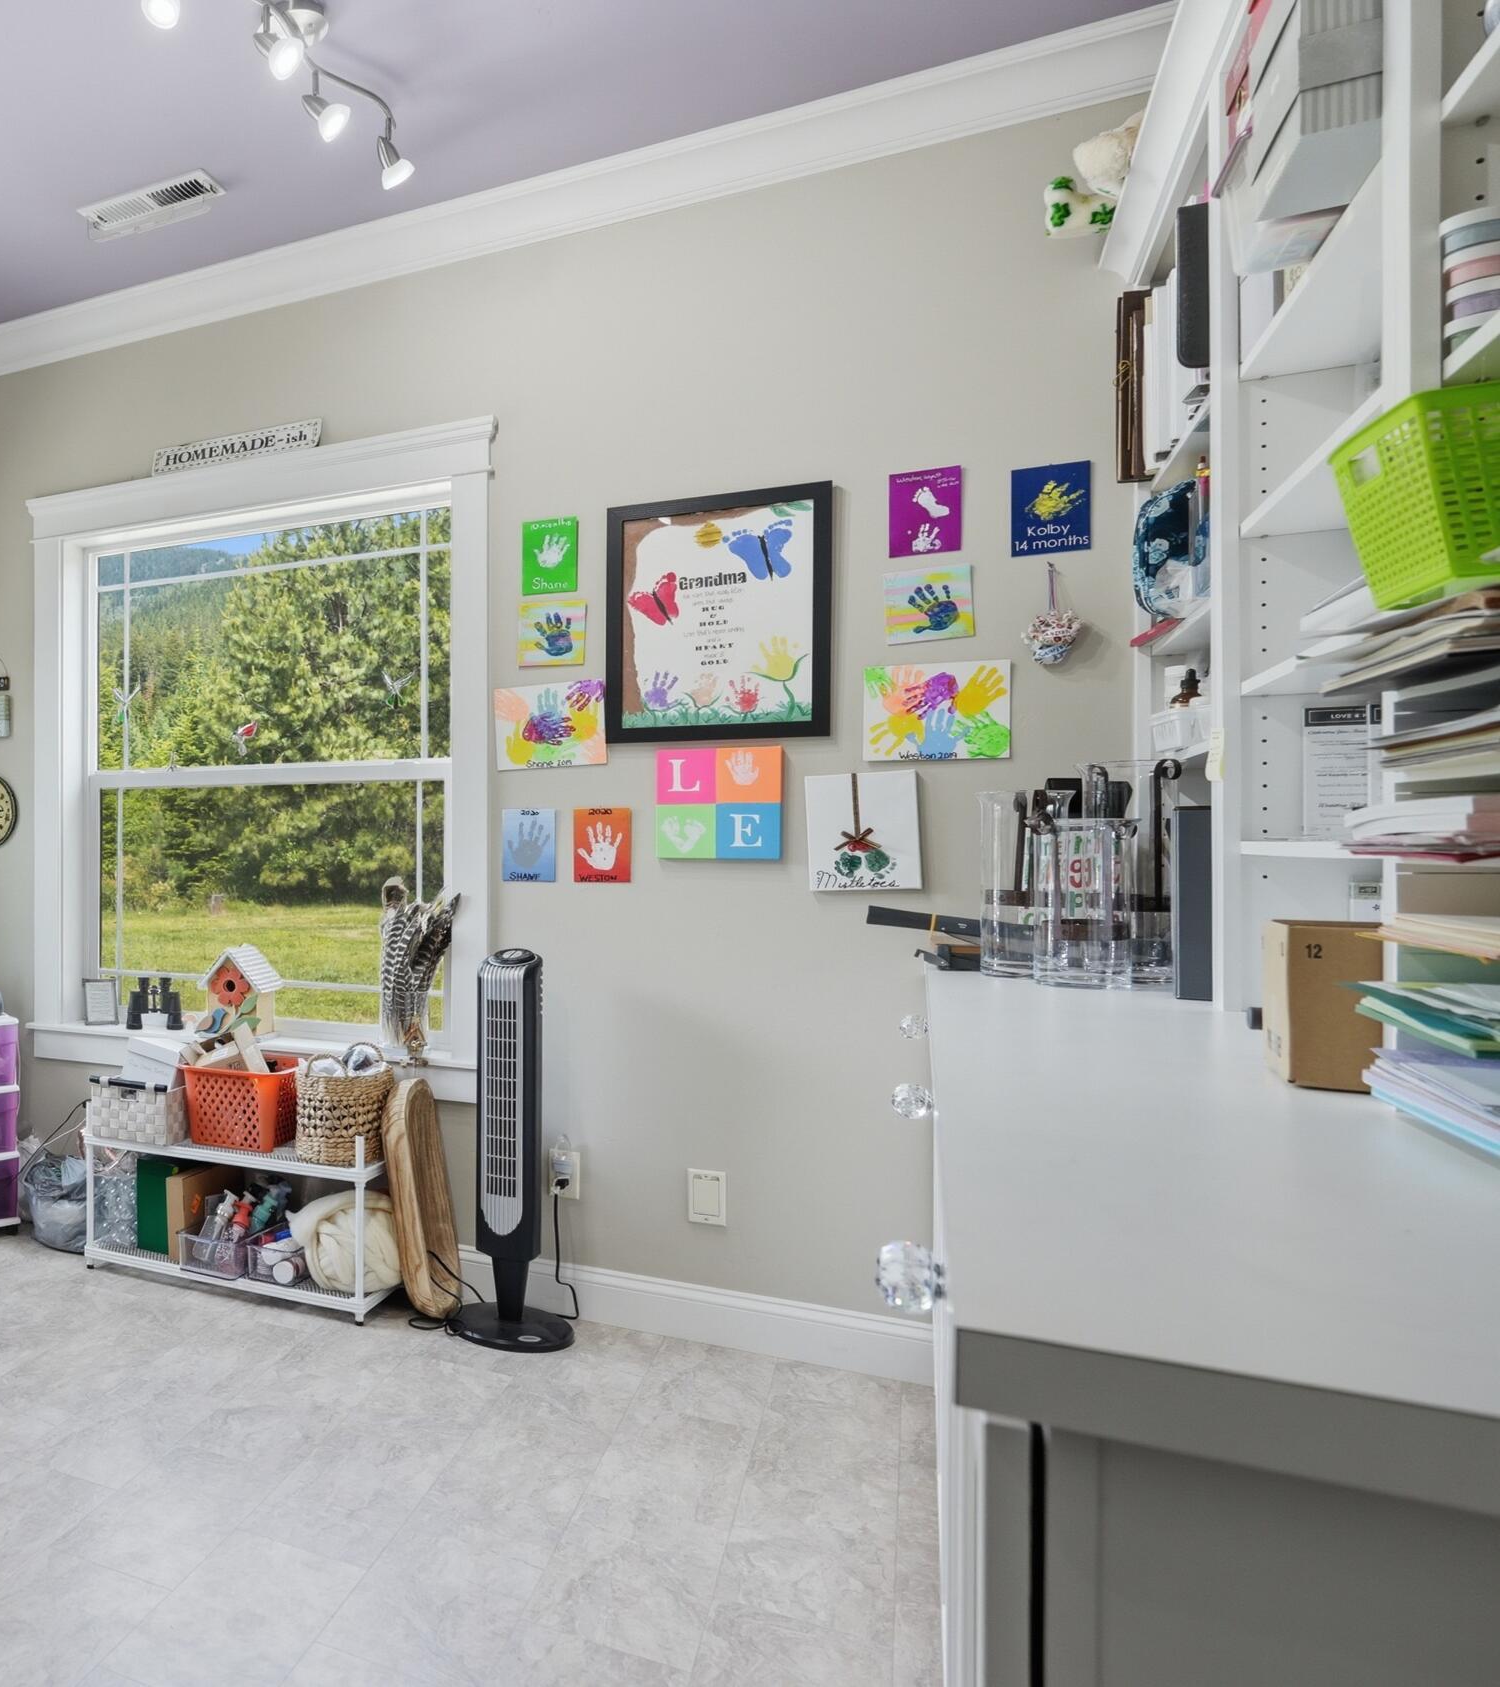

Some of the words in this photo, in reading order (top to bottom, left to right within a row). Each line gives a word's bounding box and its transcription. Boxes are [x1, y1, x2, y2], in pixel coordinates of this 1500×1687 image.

[164, 430, 308, 467] HOMEMADE-ish
[1027, 523, 1071, 539] Kolby
[1015, 540, 1030, 552] 14
[1032, 533, 1090, 550] months
[532, 576, 569, 590] Shane
[679, 571, 747, 590] Grandma
[1330, 712, 1352, 720] LOVE
[667, 758, 701, 793] L
[588, 808, 613, 816] 2020
[729, 813, 763, 848] E
[578, 874, 618, 882] WESTON
[1305, 943, 1323, 959] 12
